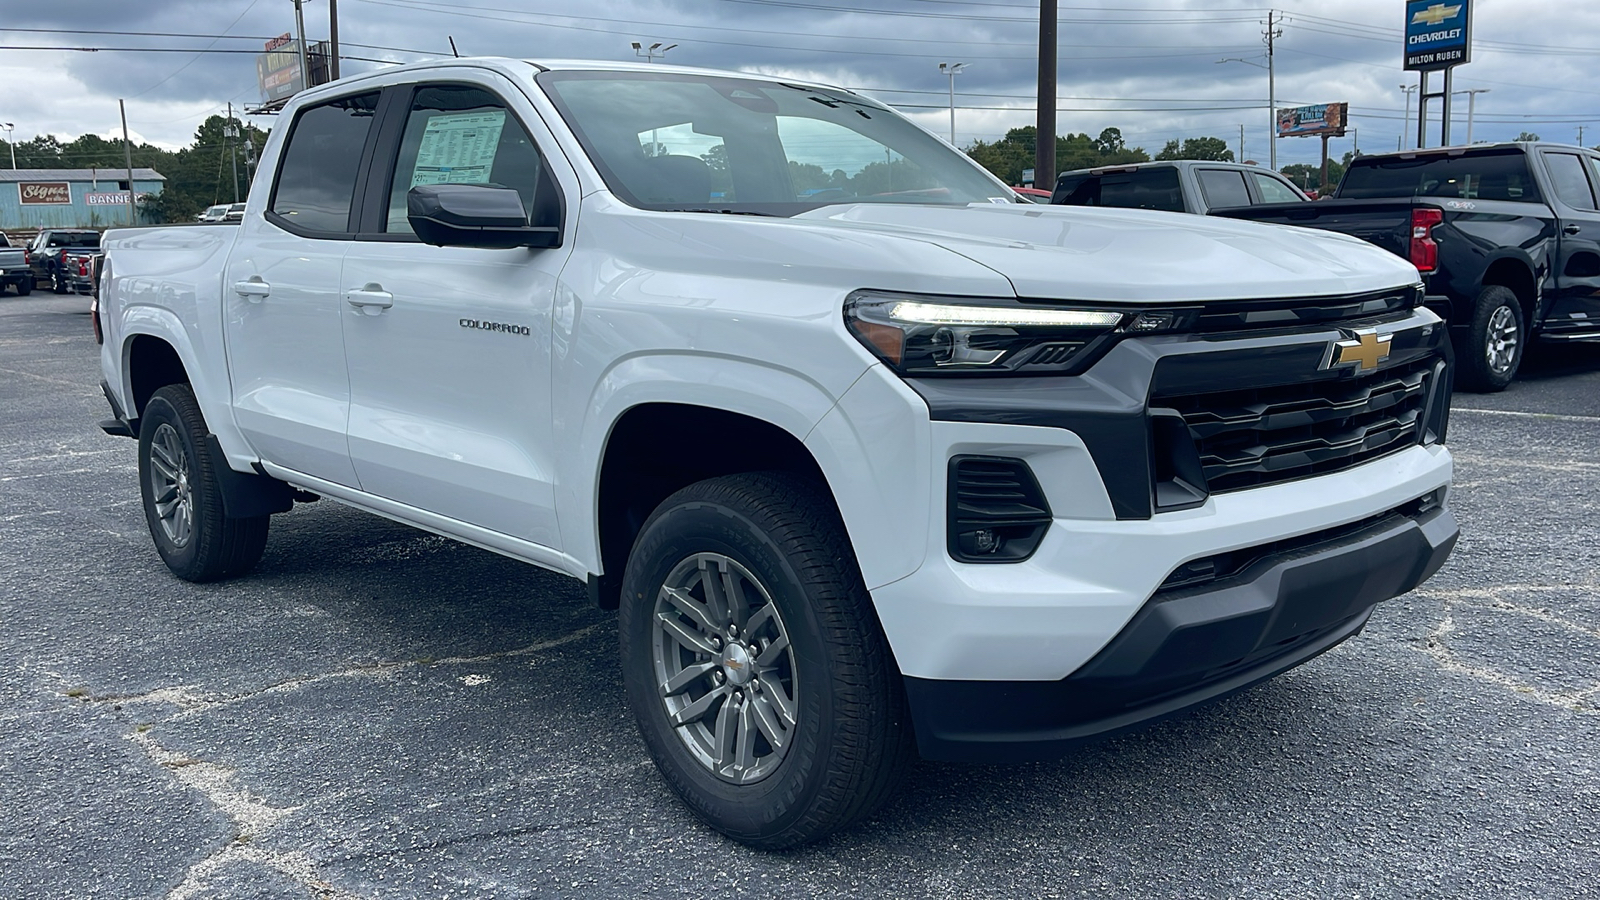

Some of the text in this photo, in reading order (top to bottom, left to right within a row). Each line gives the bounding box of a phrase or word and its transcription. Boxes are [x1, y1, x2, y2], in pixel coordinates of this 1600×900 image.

[1409, 28, 1462, 45] CHEVROLET
[1408, 50, 1462, 65] MILTON RUBEN
[459, 318, 531, 336] COLORADO
[763, 690, 822, 825] WRANGLER
